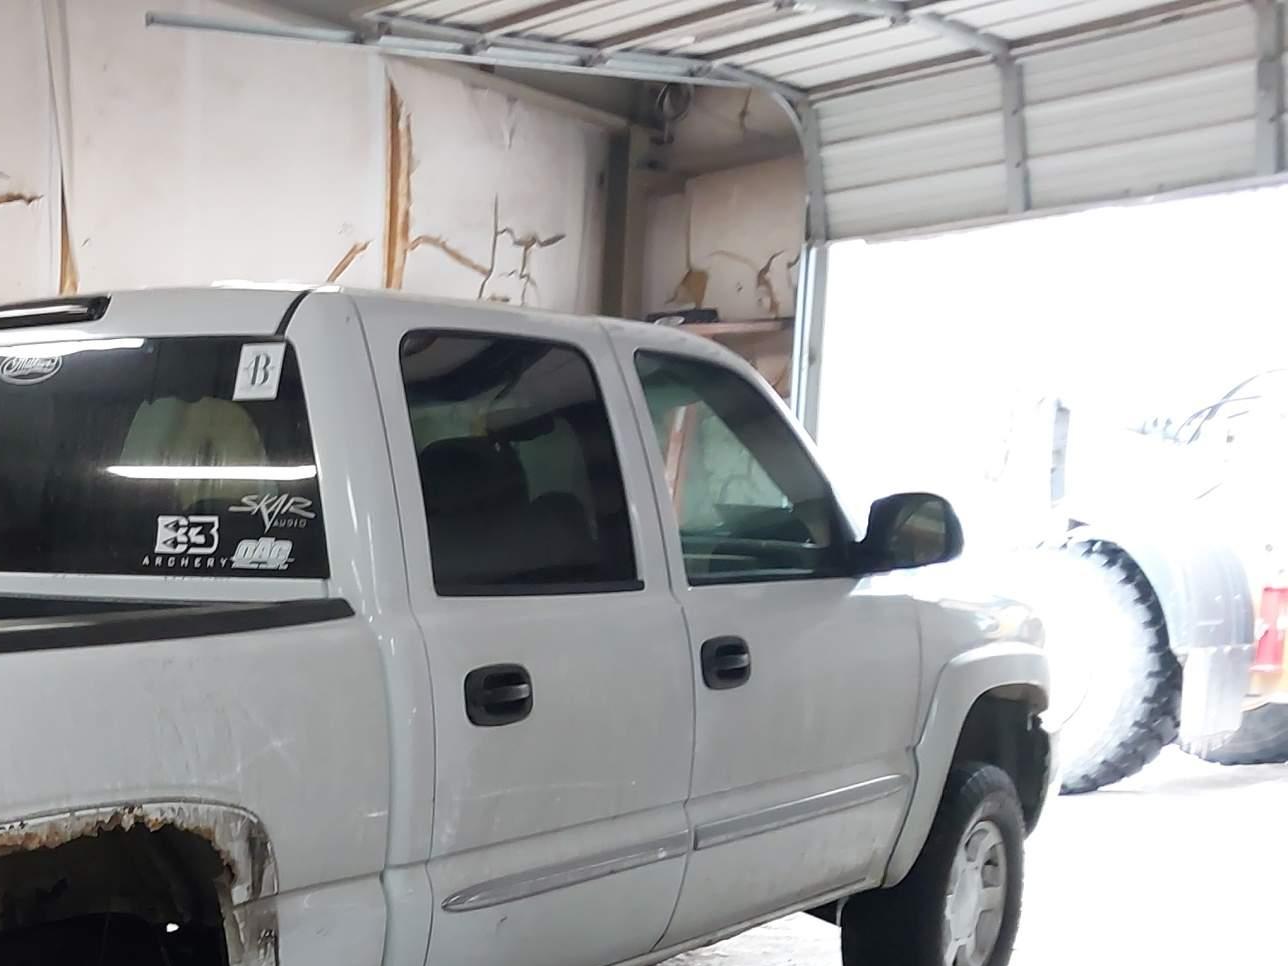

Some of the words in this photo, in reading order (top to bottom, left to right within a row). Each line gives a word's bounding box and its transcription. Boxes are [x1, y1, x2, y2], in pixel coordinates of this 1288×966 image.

[228, 494, 316, 534] SKAR
[272, 518, 307, 528] AUDIO
[142, 556, 228, 568] ARCHERY
